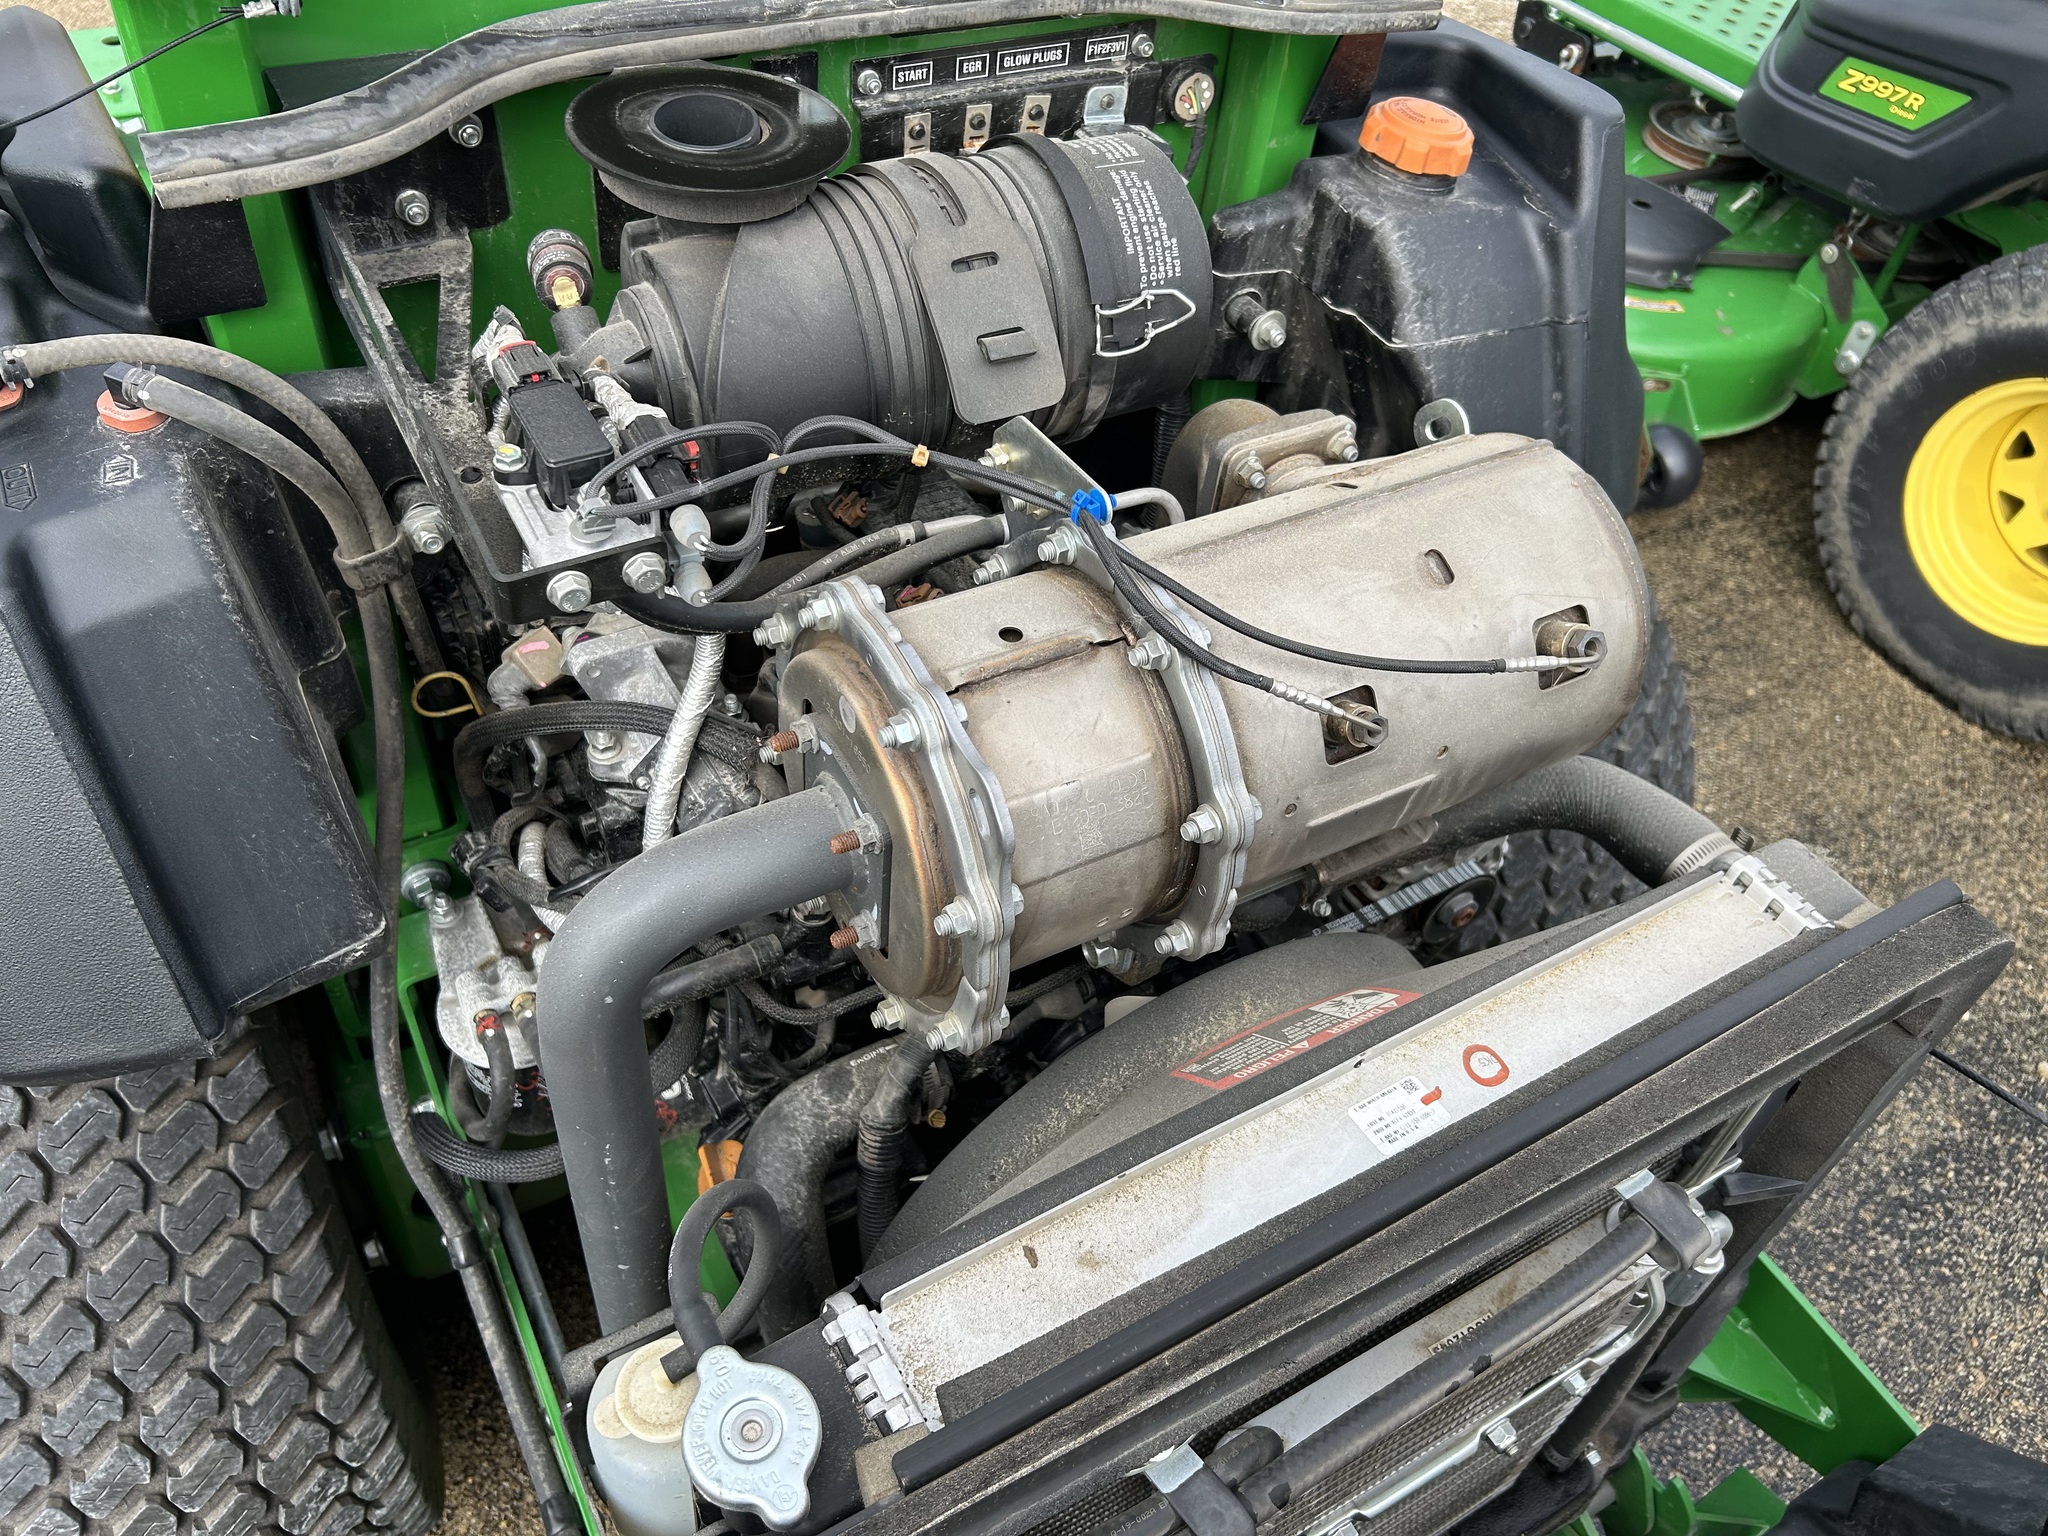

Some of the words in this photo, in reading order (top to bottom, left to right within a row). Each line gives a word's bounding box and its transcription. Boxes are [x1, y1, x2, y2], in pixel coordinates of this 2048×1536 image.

[962, 61, 983, 74] EGR
[1004, 53, 1030, 68] GLOW
[1032, 49, 1063, 65] PLUGS
[898, 68, 928, 83] START
[1837, 67, 1926, 112] Z997R
[1108, 169, 1129, 201] damage:
[1118, 170, 1134, 187] fluid
[1129, 171, 1143, 188] only
[1130, 188, 1147, 223] starting
[1139, 189, 1155, 222] cleaner
[1143, 180, 1162, 215] reaches
[1111, 197, 1135, 255] IMPORTANT
[1125, 203, 1139, 234] engine
[1150, 224, 1159, 238] air
[1157, 216, 1172, 247] gauge
[1143, 224, 1152, 243] use
[1134, 235, 1148, 273] prevent
[1146, 245, 1156, 263] not
[1155, 240, 1166, 279] Service
[1170, 237, 1179, 257] line
[1164, 250, 1174, 278] when
[1172, 259, 1182, 277] red
[1140, 275, 1148, 290] To
[4, 466, 33, 504] OUT
[785, 572, 808, 590] 3701
[1326, 1008, 1385, 1034] DANGER
[849, 1046, 887, 1067] ENGINE
[1233, 1049, 1295, 1078] PELIGRO
